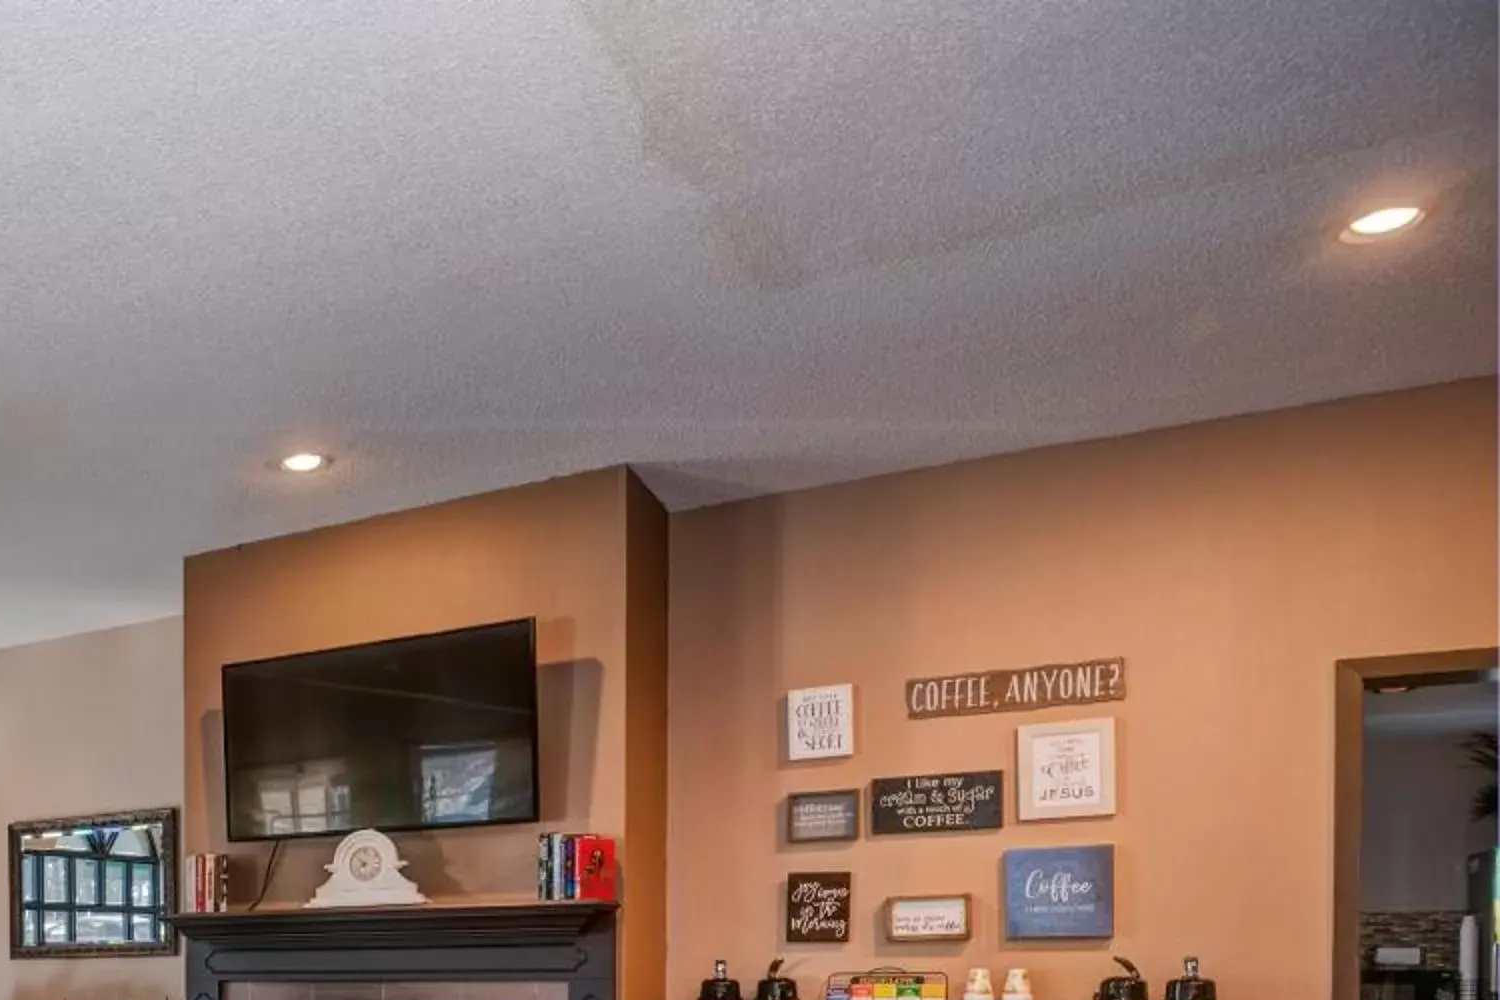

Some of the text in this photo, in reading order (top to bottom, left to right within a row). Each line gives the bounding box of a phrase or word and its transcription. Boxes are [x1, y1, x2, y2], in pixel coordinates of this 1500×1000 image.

[911, 663, 1120, 713] COFFEE, ANYONE?
[943, 777, 965, 789] my
[1040, 785, 1095, 801] JESUS
[902, 813, 969, 828] COFFEE.
[1025, 868, 1093, 903] Coffee
